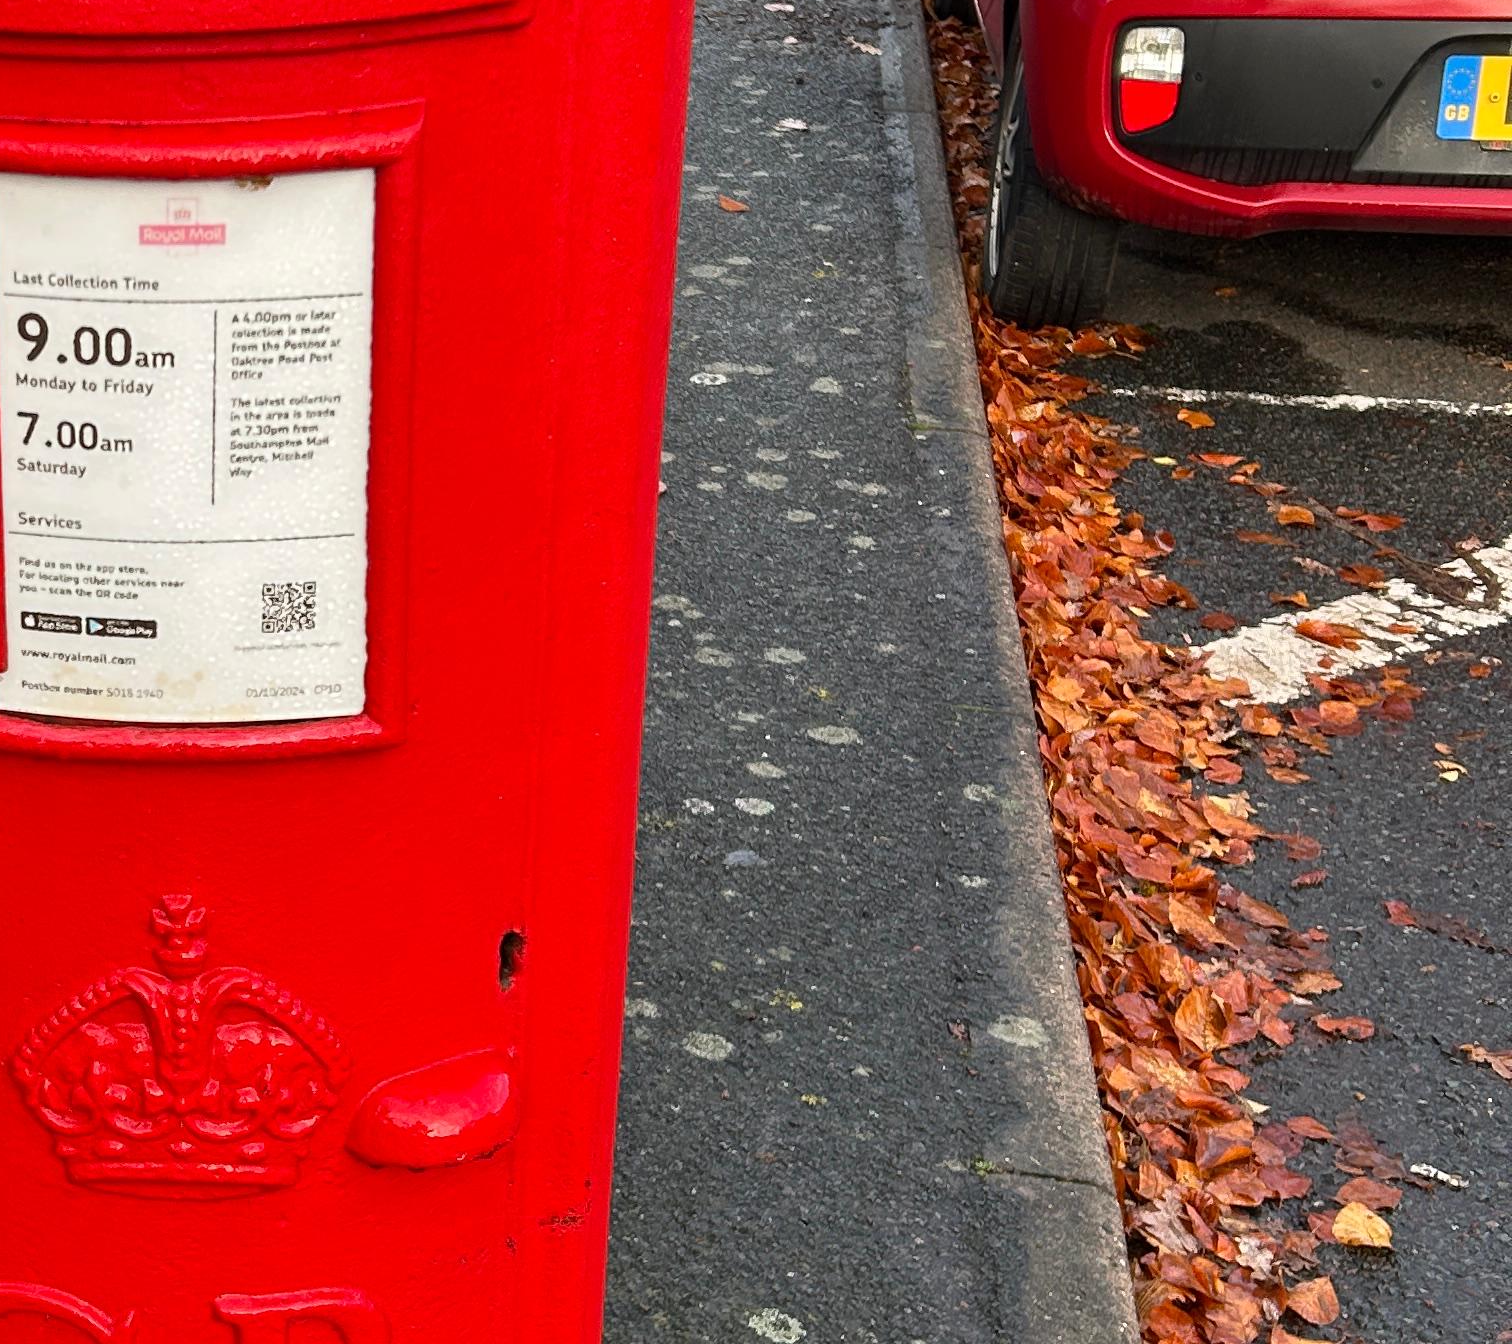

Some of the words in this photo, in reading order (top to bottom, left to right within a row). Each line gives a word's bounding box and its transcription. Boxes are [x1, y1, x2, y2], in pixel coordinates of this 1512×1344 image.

[1444, 104, 1470, 122] GB
[143, 227, 185, 243] Royal
[189, 227, 222, 241] Mail
[13, 271, 43, 286] Last
[48, 273, 118, 290] Collection
[123, 277, 159, 291] Time
[232, 314, 239, 323] A
[243, 311, 291, 324] 4.00pm
[295, 313, 307, 321] or
[288, 327, 296, 336] is
[301, 325, 330, 335] made
[17, 312, 175, 368] 9.00am
[231, 342, 257, 353] from
[262, 341, 280, 352] the
[231, 356, 274, 366] Oaktree
[309, 353, 333, 363] Post
[231, 370, 263, 380] Office
[16, 373, 76, 394] Monday
[82, 379, 97, 392] to
[104, 379, 154, 397] Friday
[231, 398, 250, 408] The
[254, 397, 285, 406] latest
[289, 395, 341, 405] collection
[230, 411, 240, 422] in
[244, 411, 262, 421] the
[266, 411, 289, 420] area
[293, 410, 301, 419] is
[306, 408, 335, 418] made
[17, 411, 133, 453] 7.00am
[230, 427, 241, 437] at
[244, 424, 289, 436] 7.30pm
[293, 424, 319, 434] from
[229, 453, 268, 464] Centre,
[16, 457, 87, 478] Saturday
[229, 467, 252, 478] Way
[18, 511, 82, 530] Services
[19, 556, 40, 567] Find
[45, 561, 56, 569] us
[59, 562, 72, 570] on
[76, 562, 91, 572] the
[96, 565, 115, 574] app
[19, 570, 35, 579] For
[39, 572, 79, 585] locating
[82, 575, 110, 586] other
[114, 578, 157, 588] services
[161, 579, 185, 588] near
[19, 584, 37, 593] you
[49, 587, 72, 596] scan
[75, 587, 92, 597] the
[95, 589, 111, 599] QR
[113, 590, 139, 600] code
[106, 625, 136, 636] Google
[21, 649, 136, 665] www.royalmail.com
[21, 679, 61, 693] Postbox
[63, 685, 104, 697] number
